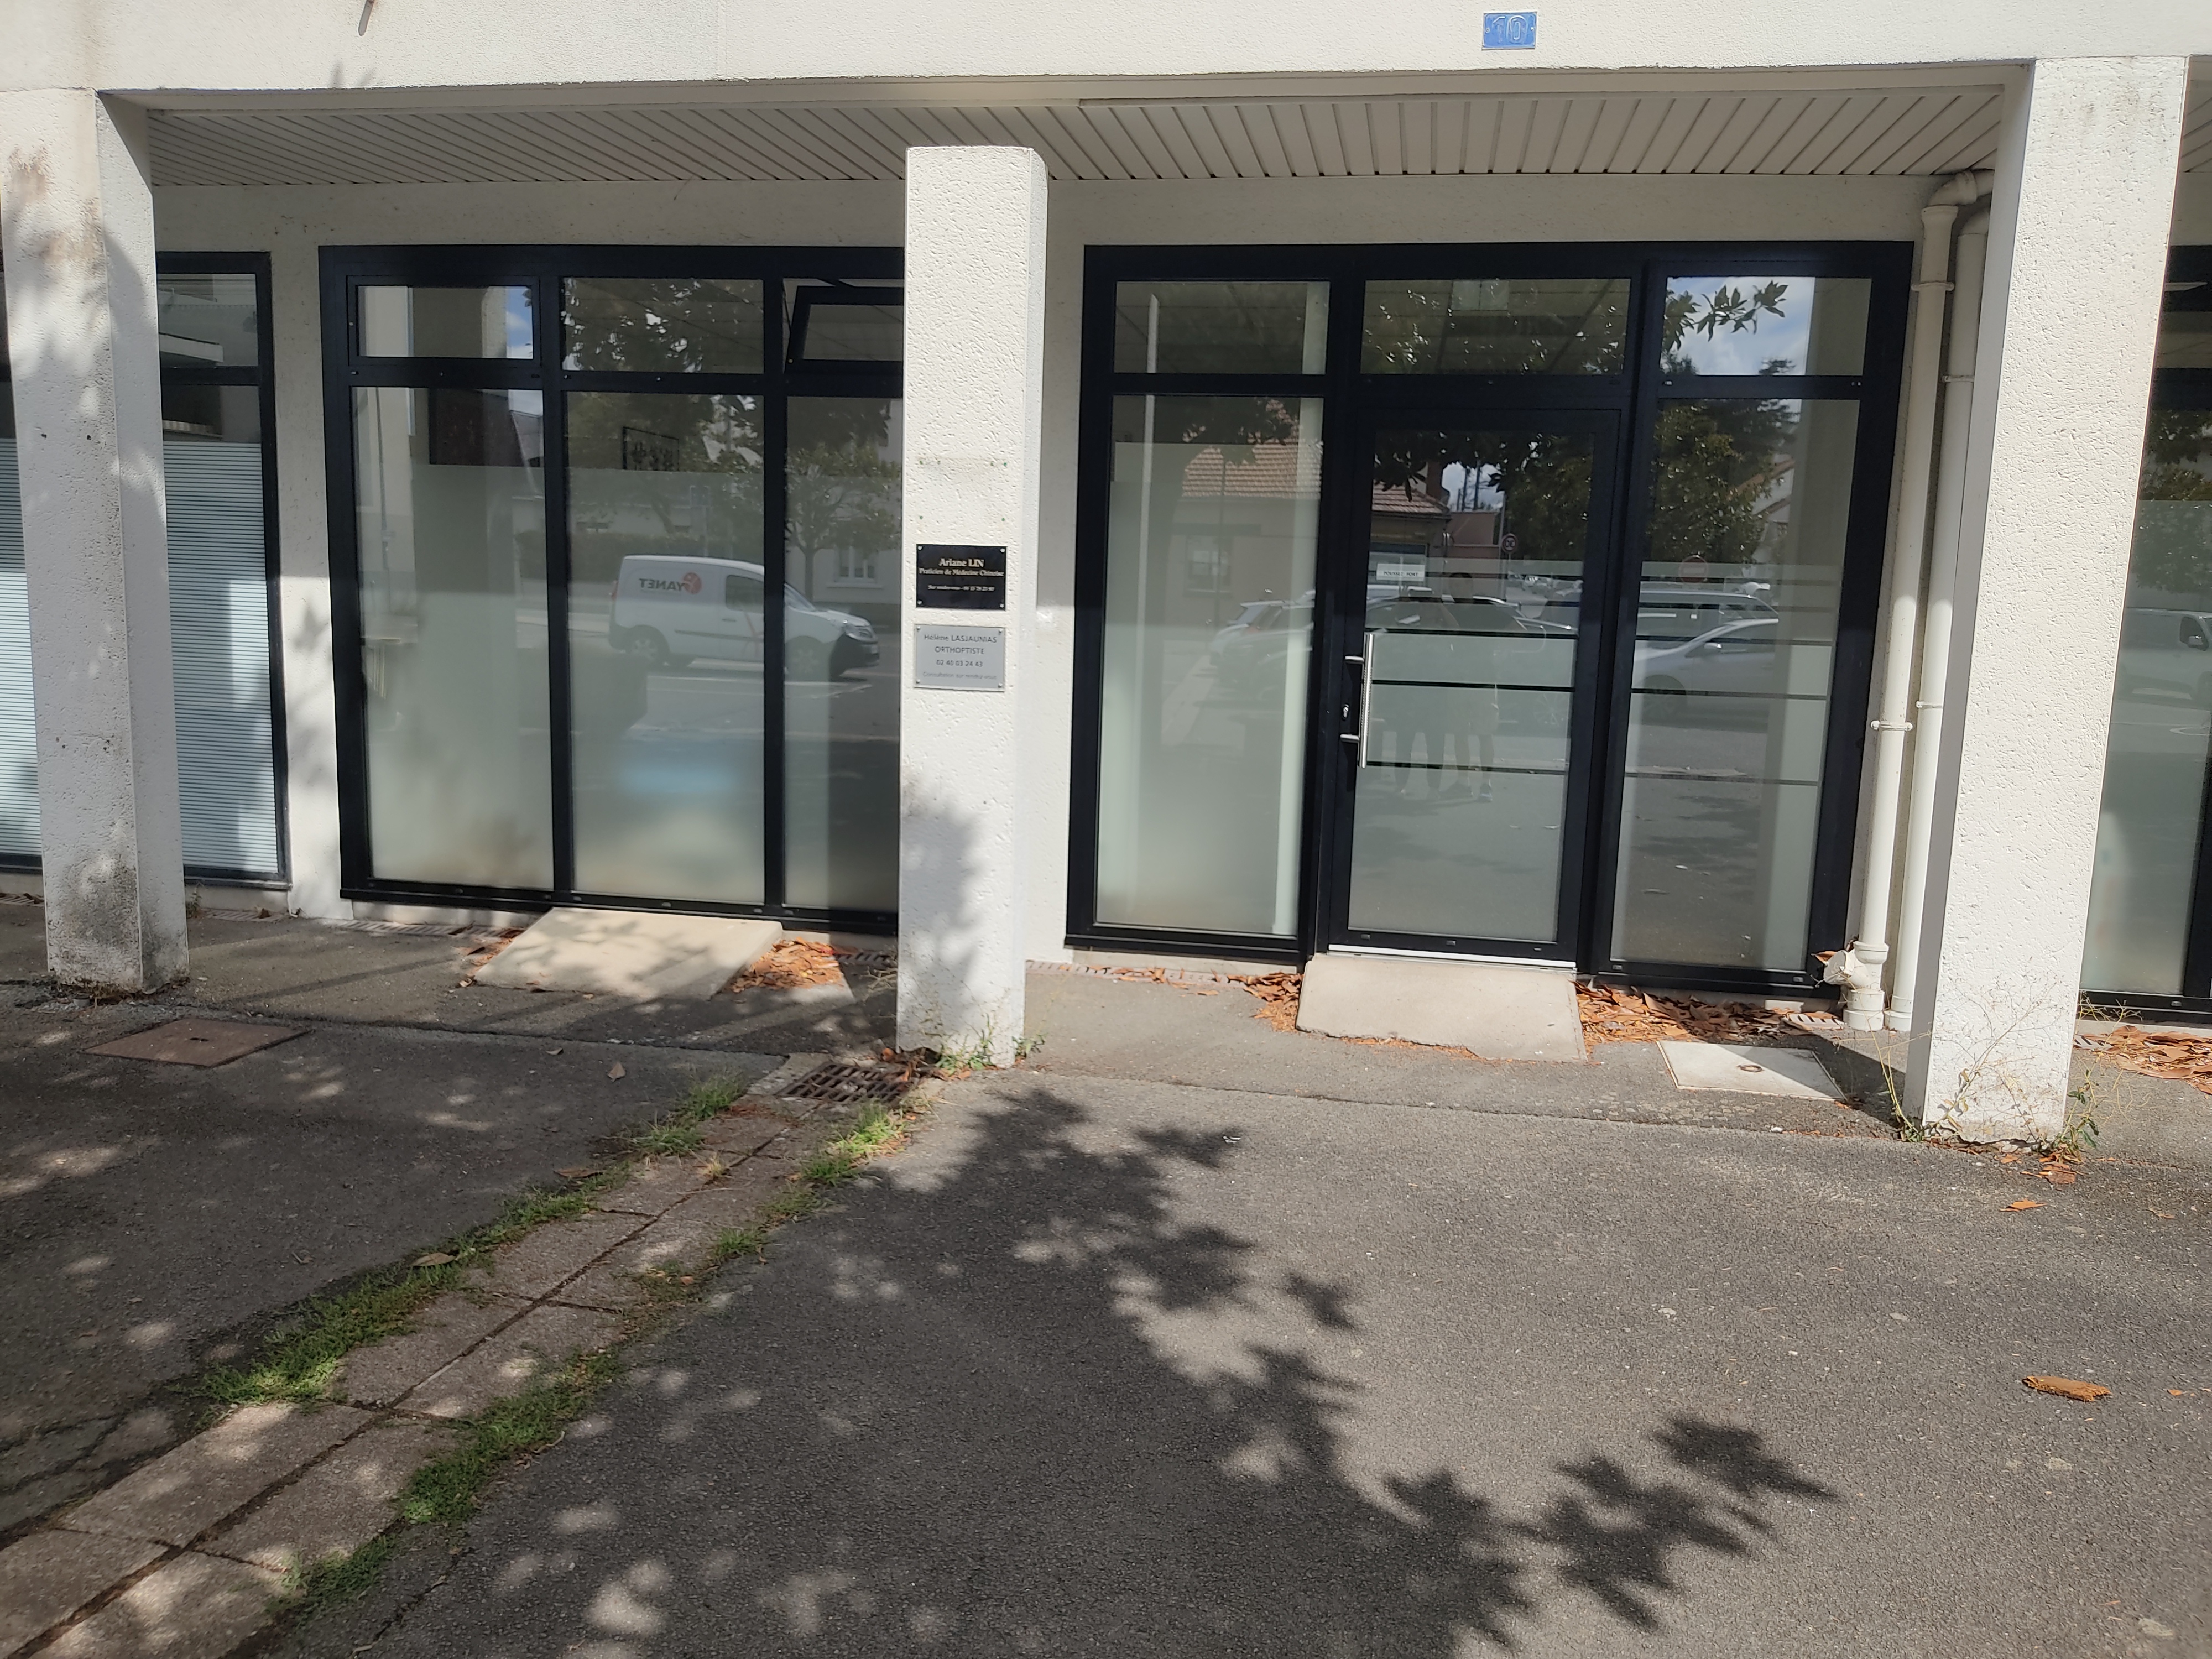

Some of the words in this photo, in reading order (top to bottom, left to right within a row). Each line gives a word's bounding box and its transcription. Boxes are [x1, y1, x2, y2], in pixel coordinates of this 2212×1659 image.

[1493, 15, 1526, 44] 10
[938, 557, 967, 567] Ariane
[968, 559, 984, 567] LIN
[935, 646, 985, 654] ORTHOPTISTE
